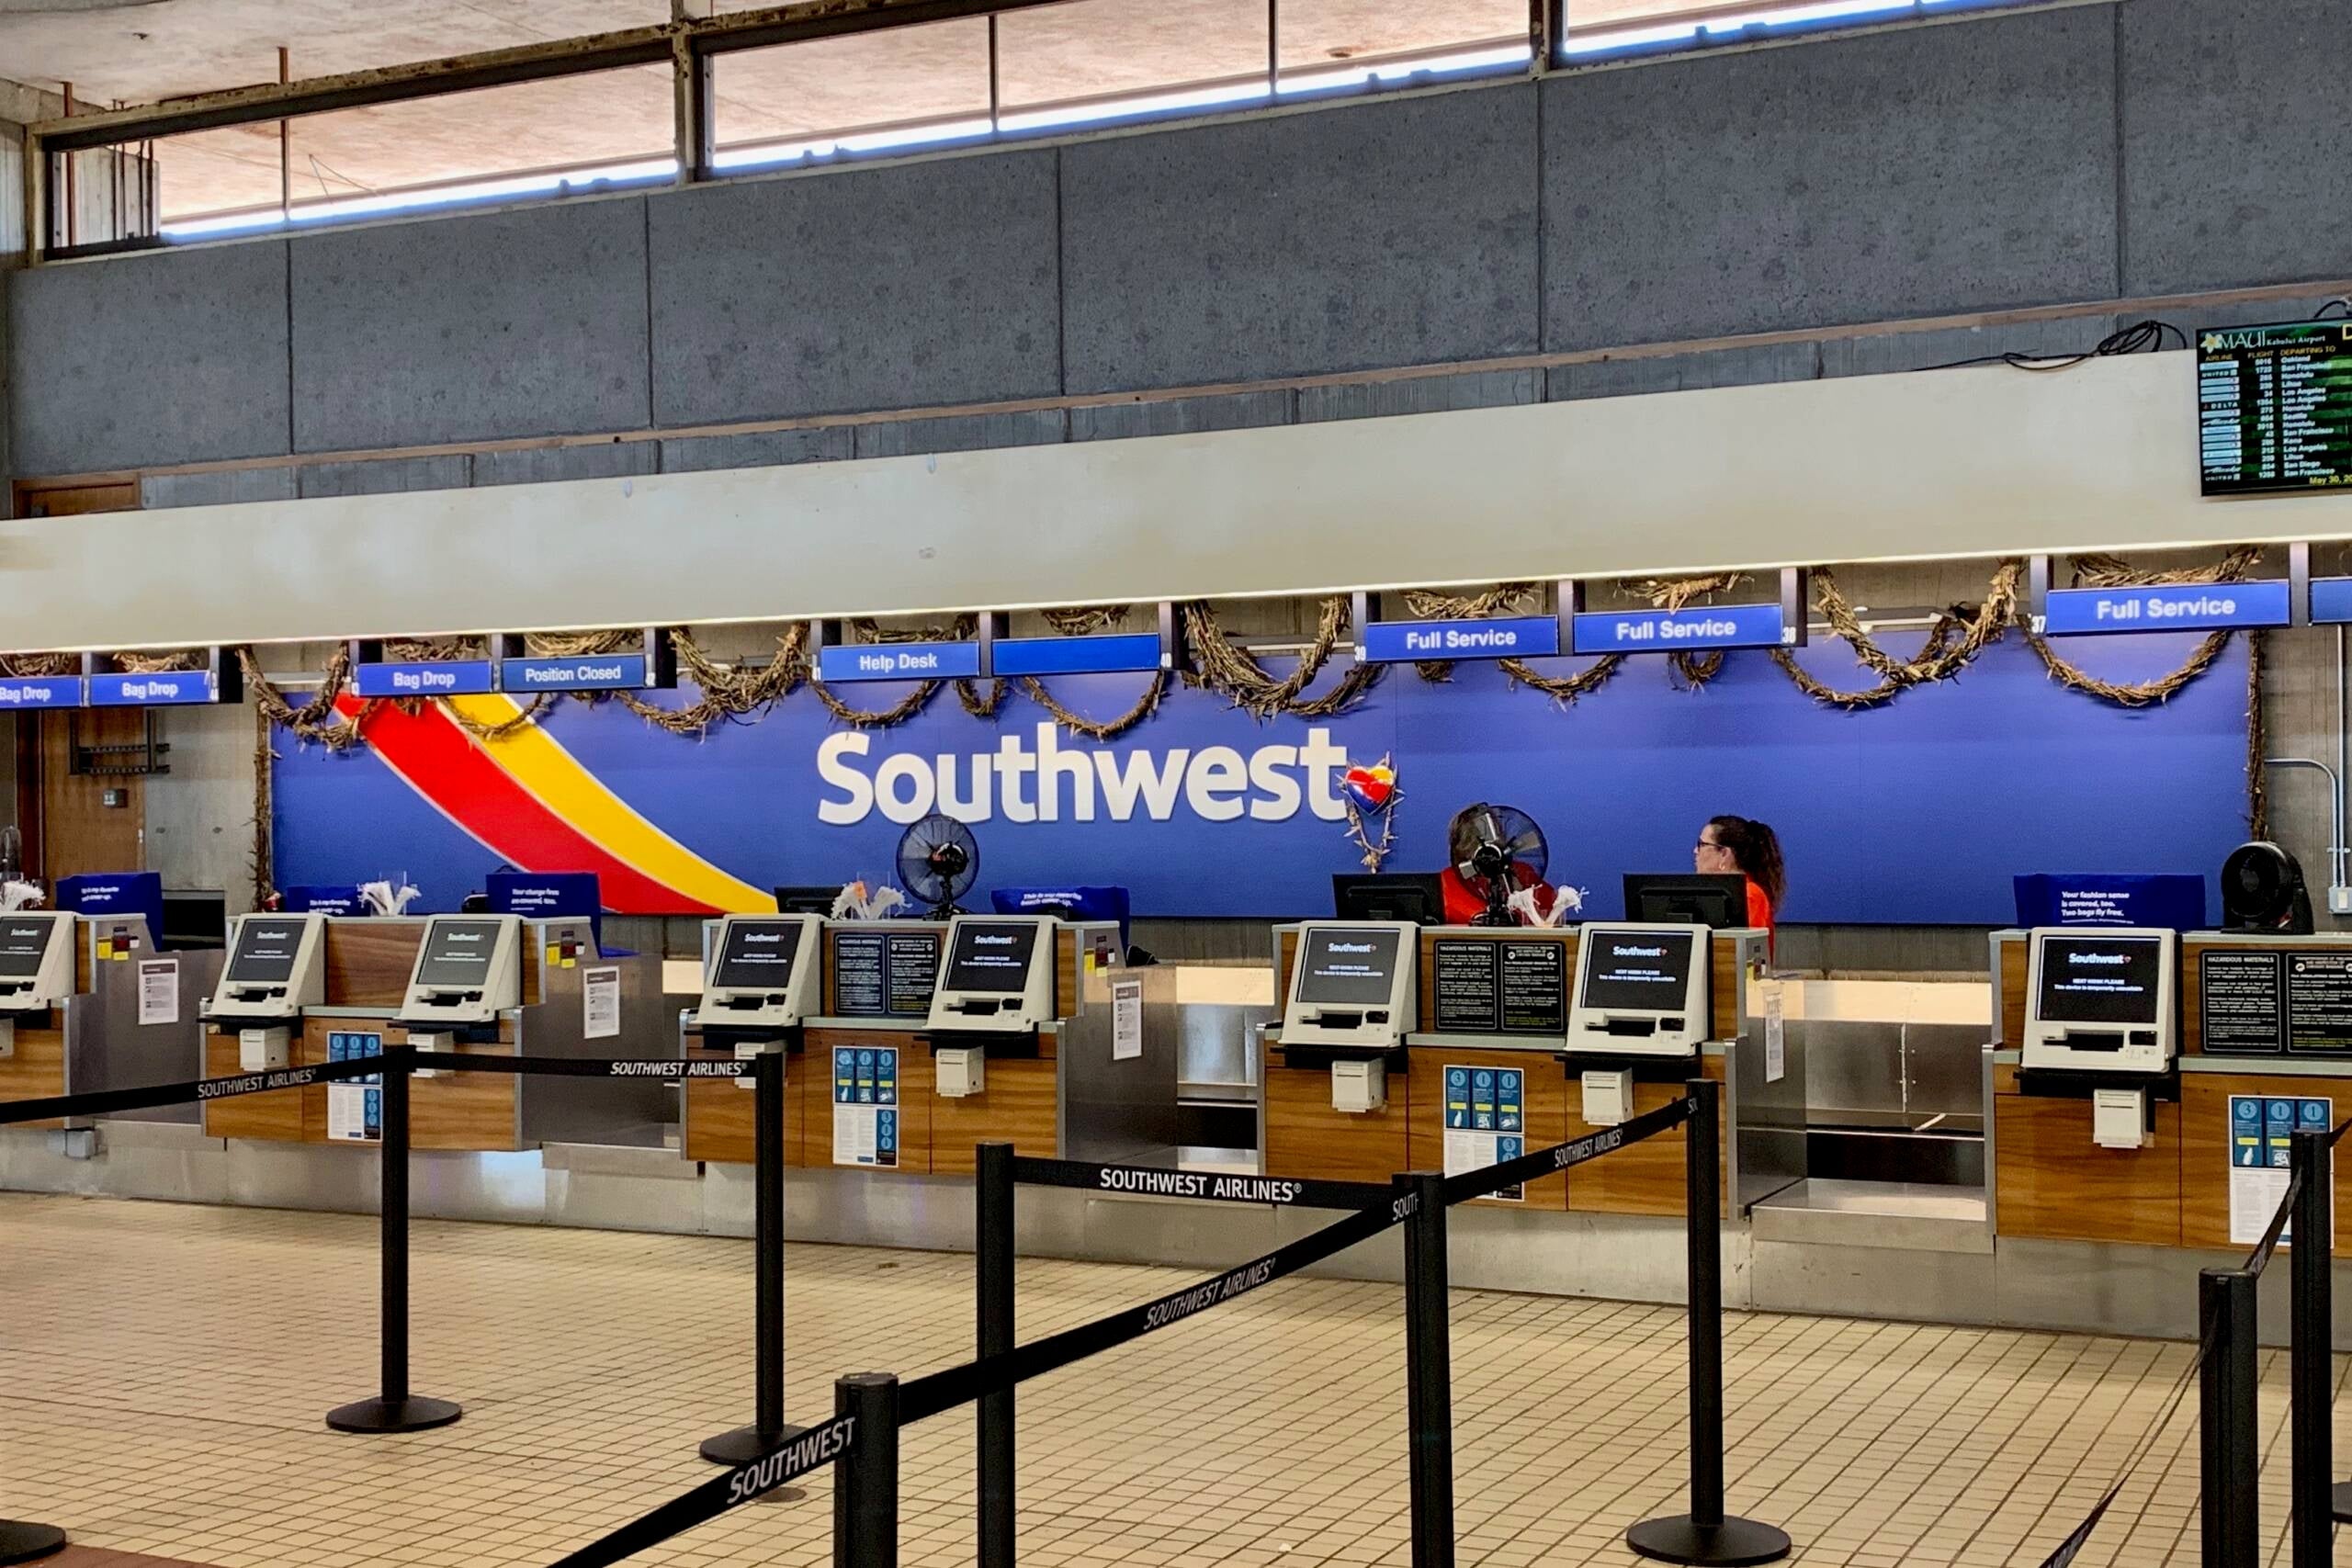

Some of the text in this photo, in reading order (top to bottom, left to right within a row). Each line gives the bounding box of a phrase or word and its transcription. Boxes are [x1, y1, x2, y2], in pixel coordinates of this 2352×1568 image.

[2221, 330, 2266, 349] MAUI
[2298, 335, 2325, 344] Airport
[2247, 350, 2274, 359] FLIGHT
[2280, 347, 2324, 355] DEPARTING
[2297, 388, 2326, 396] Angeles
[2297, 395, 2326, 404] Angeles
[2299, 427, 2335, 435] Francisco
[2299, 444, 2328, 453] Angeles
[2309, 477, 2327, 486] May
[2097, 596, 2236, 620] Full Service
[1616, 618, 1736, 641] Full Service
[2031, 615, 2046, 634] 37
[1406, 628, 1517, 649] Full Service
[1782, 626, 1797, 644] 38
[1354, 645, 1367, 661] 39
[859, 653, 938, 673] Help Desk
[393, 671, 456, 689] Bag Drop
[525, 665, 621, 683] Position Closed
[0, 686, 51, 704] Bag Drop
[121, 681, 178, 699] Bag Drop
[817, 722, 1349, 825] Southwest
[2062, 890, 2130, 899] Your fashion sense
[2069, 899, 2099, 908] covered,
[2100, 899, 2115, 908] too.
[2062, 908, 2124, 918] Two bags fly free.
[974, 934, 1012, 944] Southwest
[1328, 942, 1371, 953] Southwest
[1612, 945, 1661, 956] Southwest
[2068, 952, 2125, 964] Southwest
[610, 1061, 685, 1076] SOUTHWEST
[198, 1076, 264, 1099] SOUTHWEST
[1555, 1139, 1594, 1168] SOUTHWEST
[1100, 1168, 1207, 1196] SOUTHWEST
[1143, 1280, 1222, 1331] SOUTHWEST
[727, 1416, 856, 1505] SOUTHWEST
